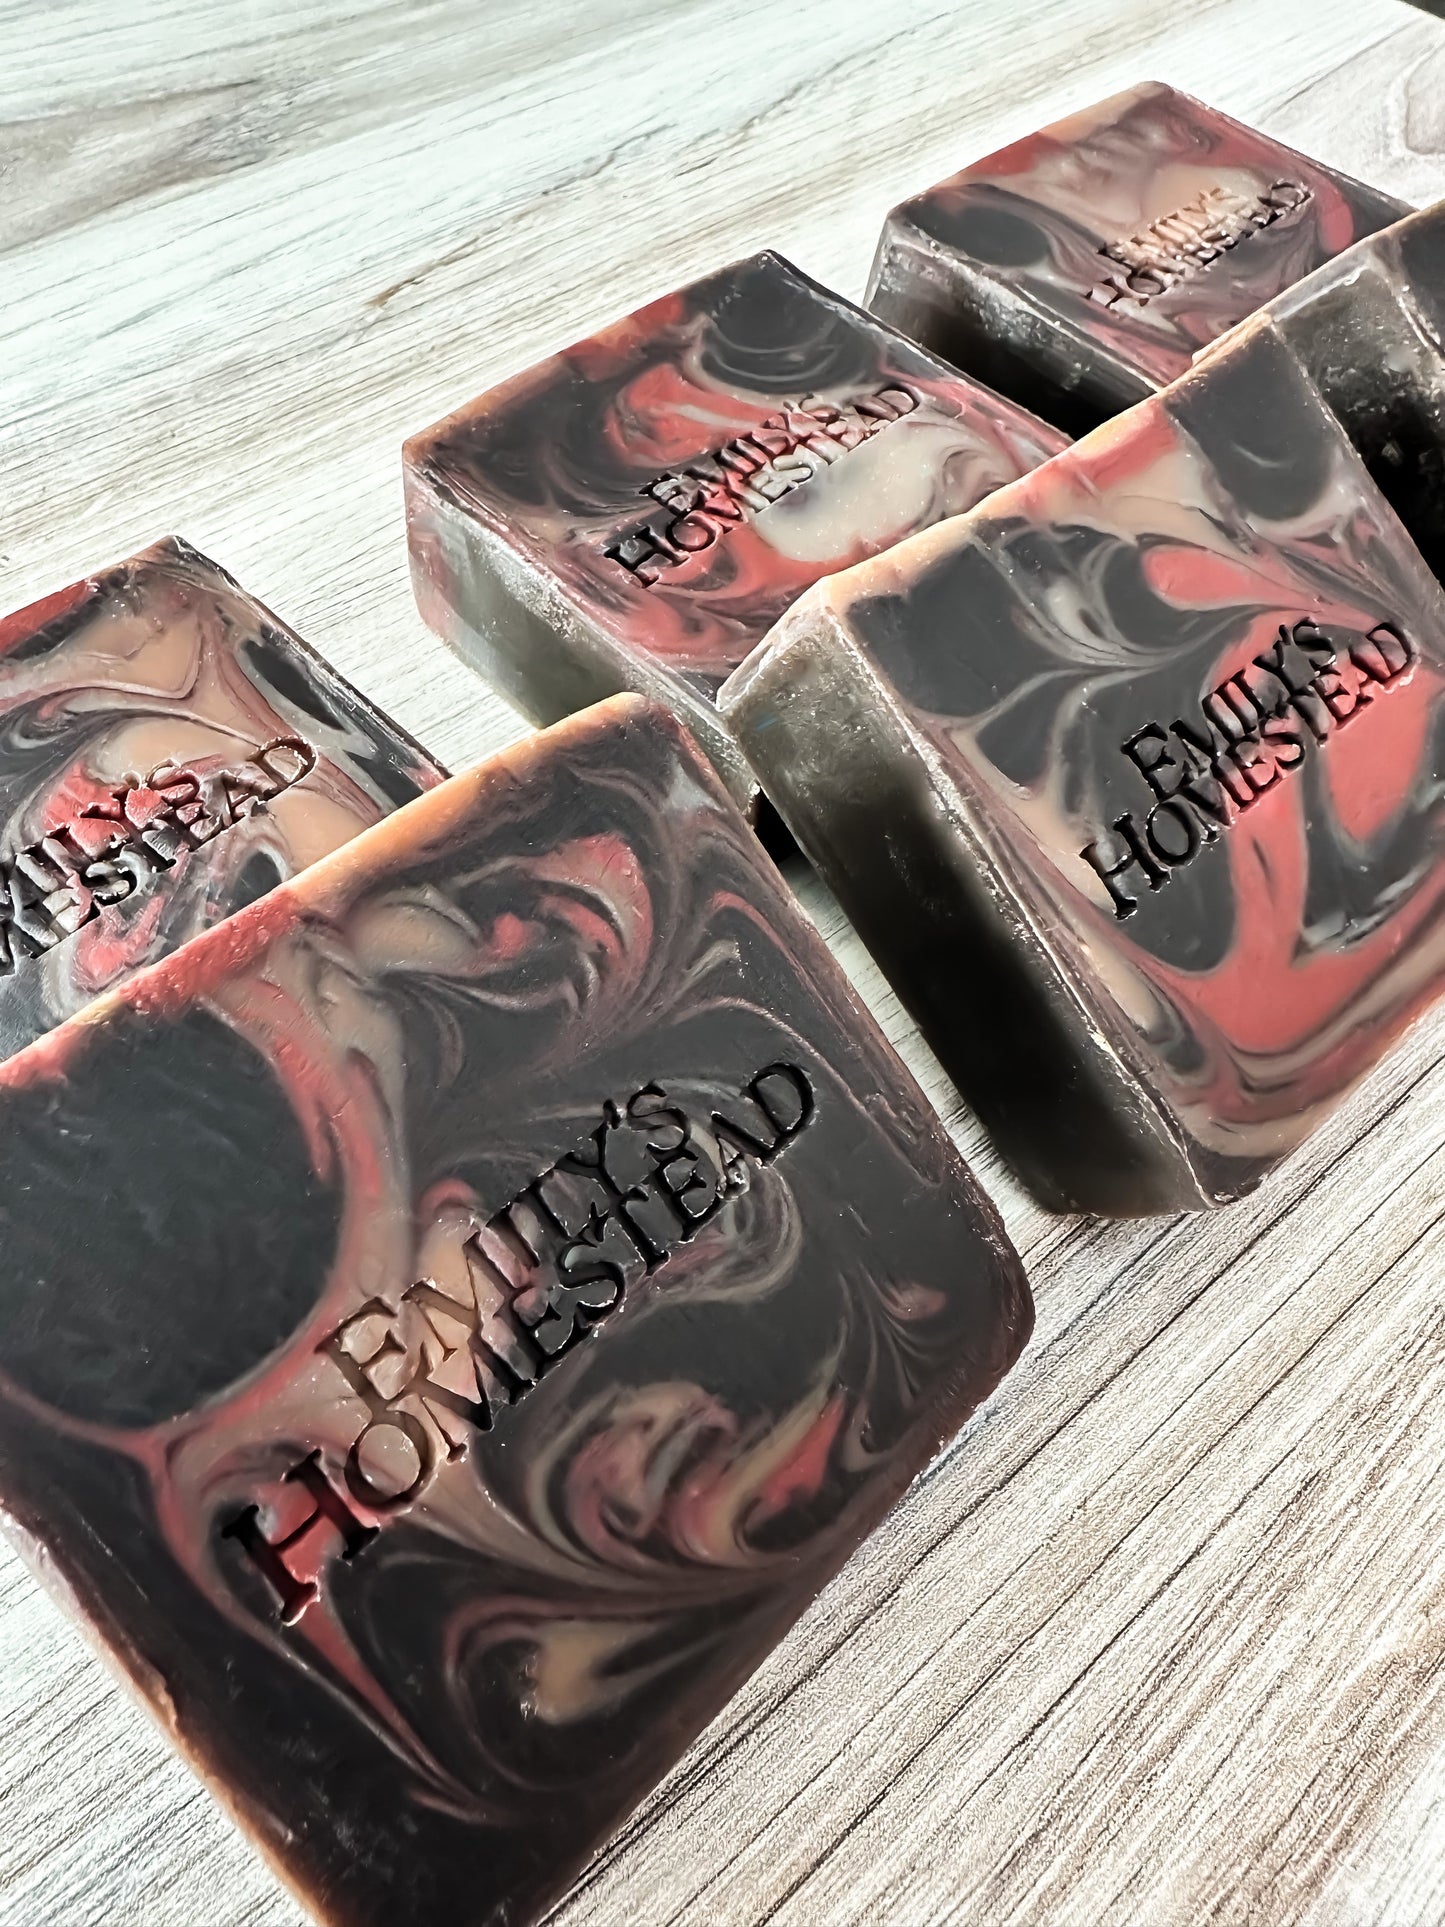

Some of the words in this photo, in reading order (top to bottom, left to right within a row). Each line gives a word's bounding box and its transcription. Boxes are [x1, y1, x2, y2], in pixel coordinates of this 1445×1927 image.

[1084, 178, 1314, 307] HOMESTEAD
[1098, 187, 1238, 272] EMILY'S
[604, 384, 919, 588] HOMESTEAD
[639, 393, 840, 518] EMILY'S
[1079, 622, 1415, 920] HOMESTEAD
[1120, 617, 1336, 801] EMILY'S
[221, 1062, 815, 1626] HOMESTEAD
[314, 1082, 692, 1415] EMILY'S
